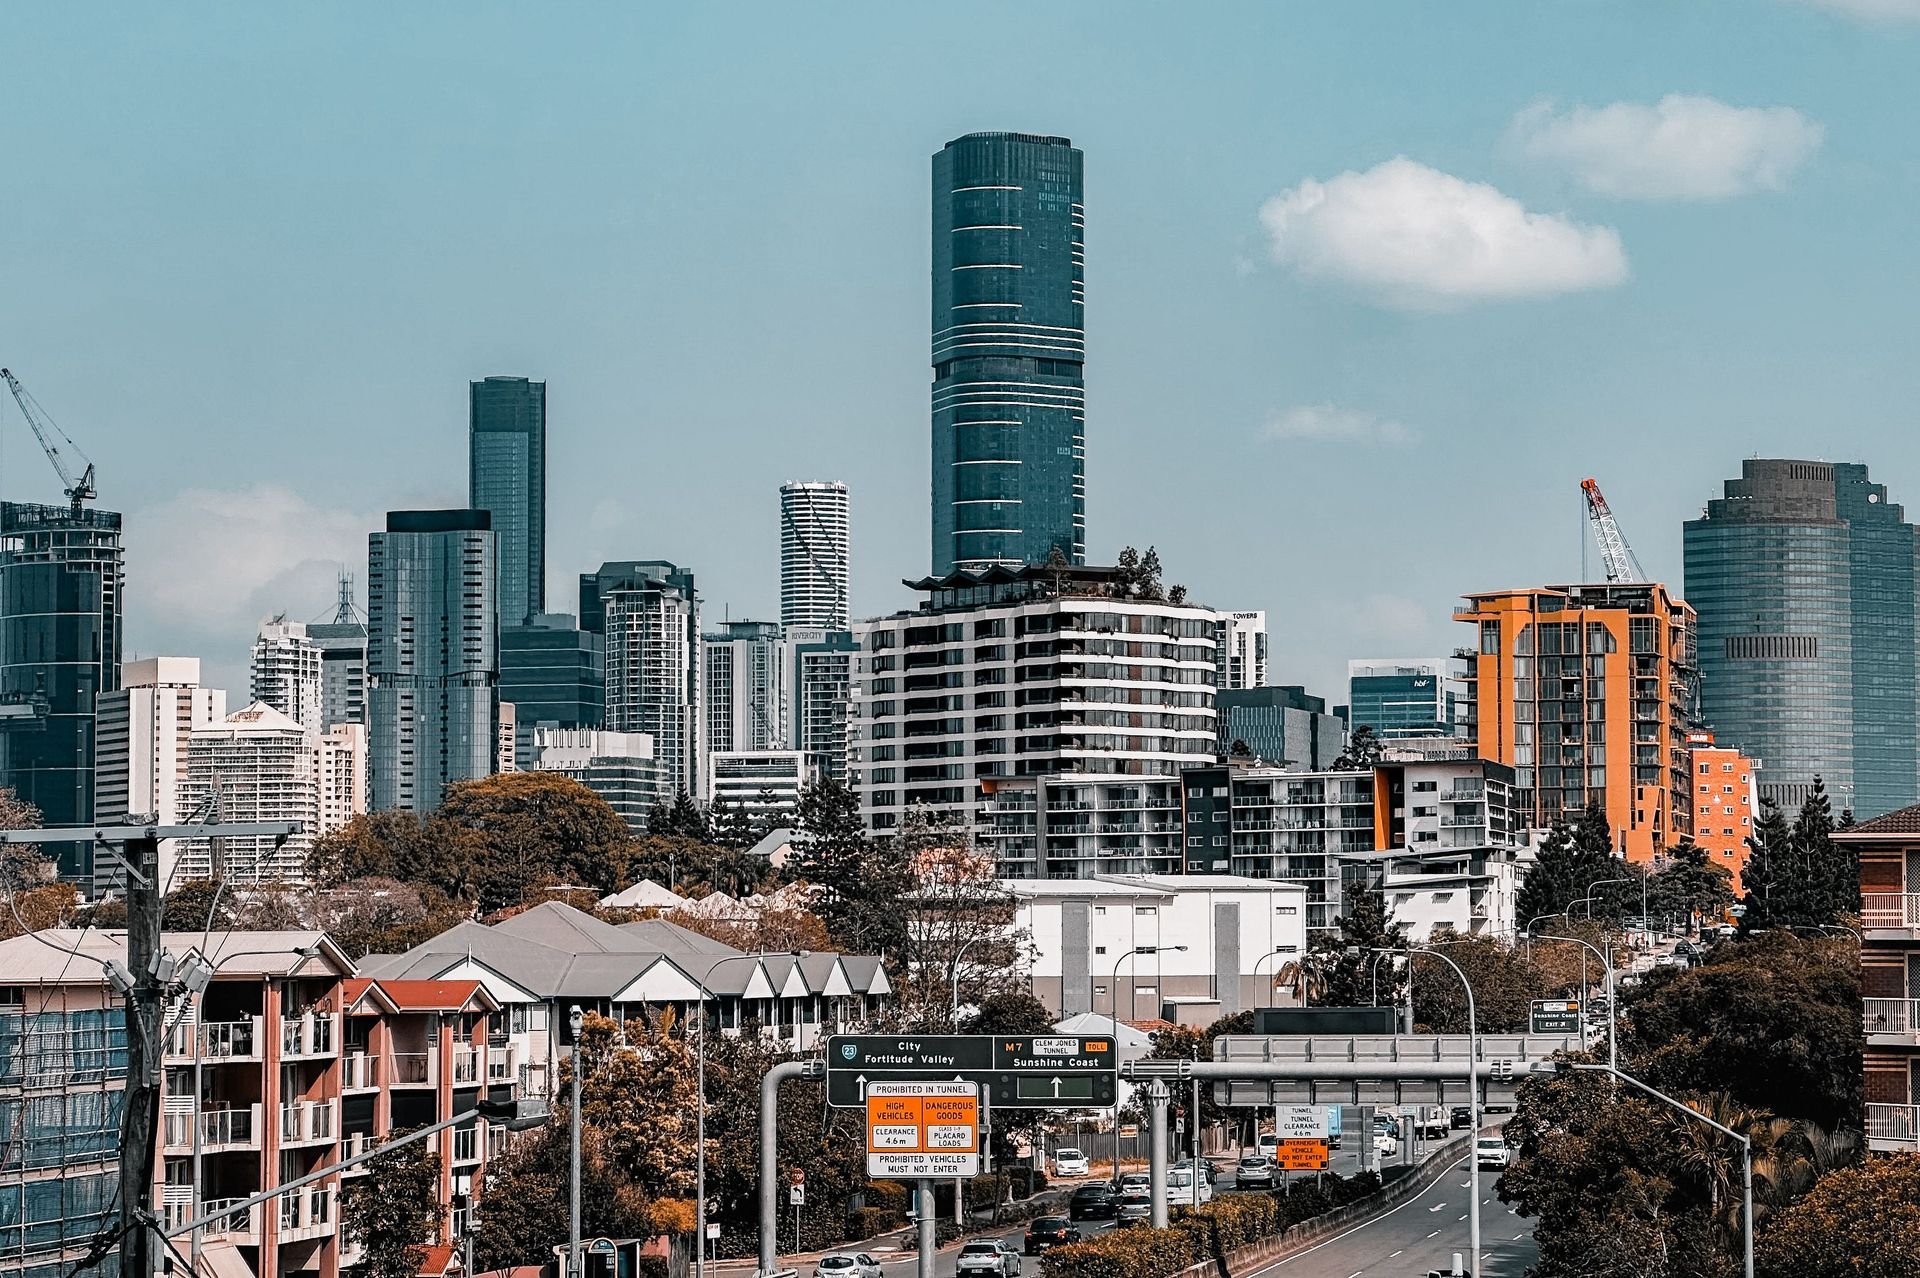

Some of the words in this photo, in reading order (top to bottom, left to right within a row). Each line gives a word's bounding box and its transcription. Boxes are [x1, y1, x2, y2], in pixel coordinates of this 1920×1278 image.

[844, 1046, 855, 1056] 23
[898, 1042, 921, 1052] City
[865, 1055, 914, 1064] Fortitude
[921, 1055, 955, 1065] Valley
[1014, 1058, 1064, 1067] Sunshine
[1069, 1058, 1099, 1067] Coast
[876, 1086, 922, 1094] PROHIBITED
[886, 1102, 904, 1110] HIGH
[877, 1112, 914, 1120] VEHICLES
[937, 1112, 962, 1120] GOODS
[879, 1156, 924, 1164] PROHIBITED
[929, 1156, 966, 1164] VEHICLES
[888, 1166, 910, 1174] MUST
